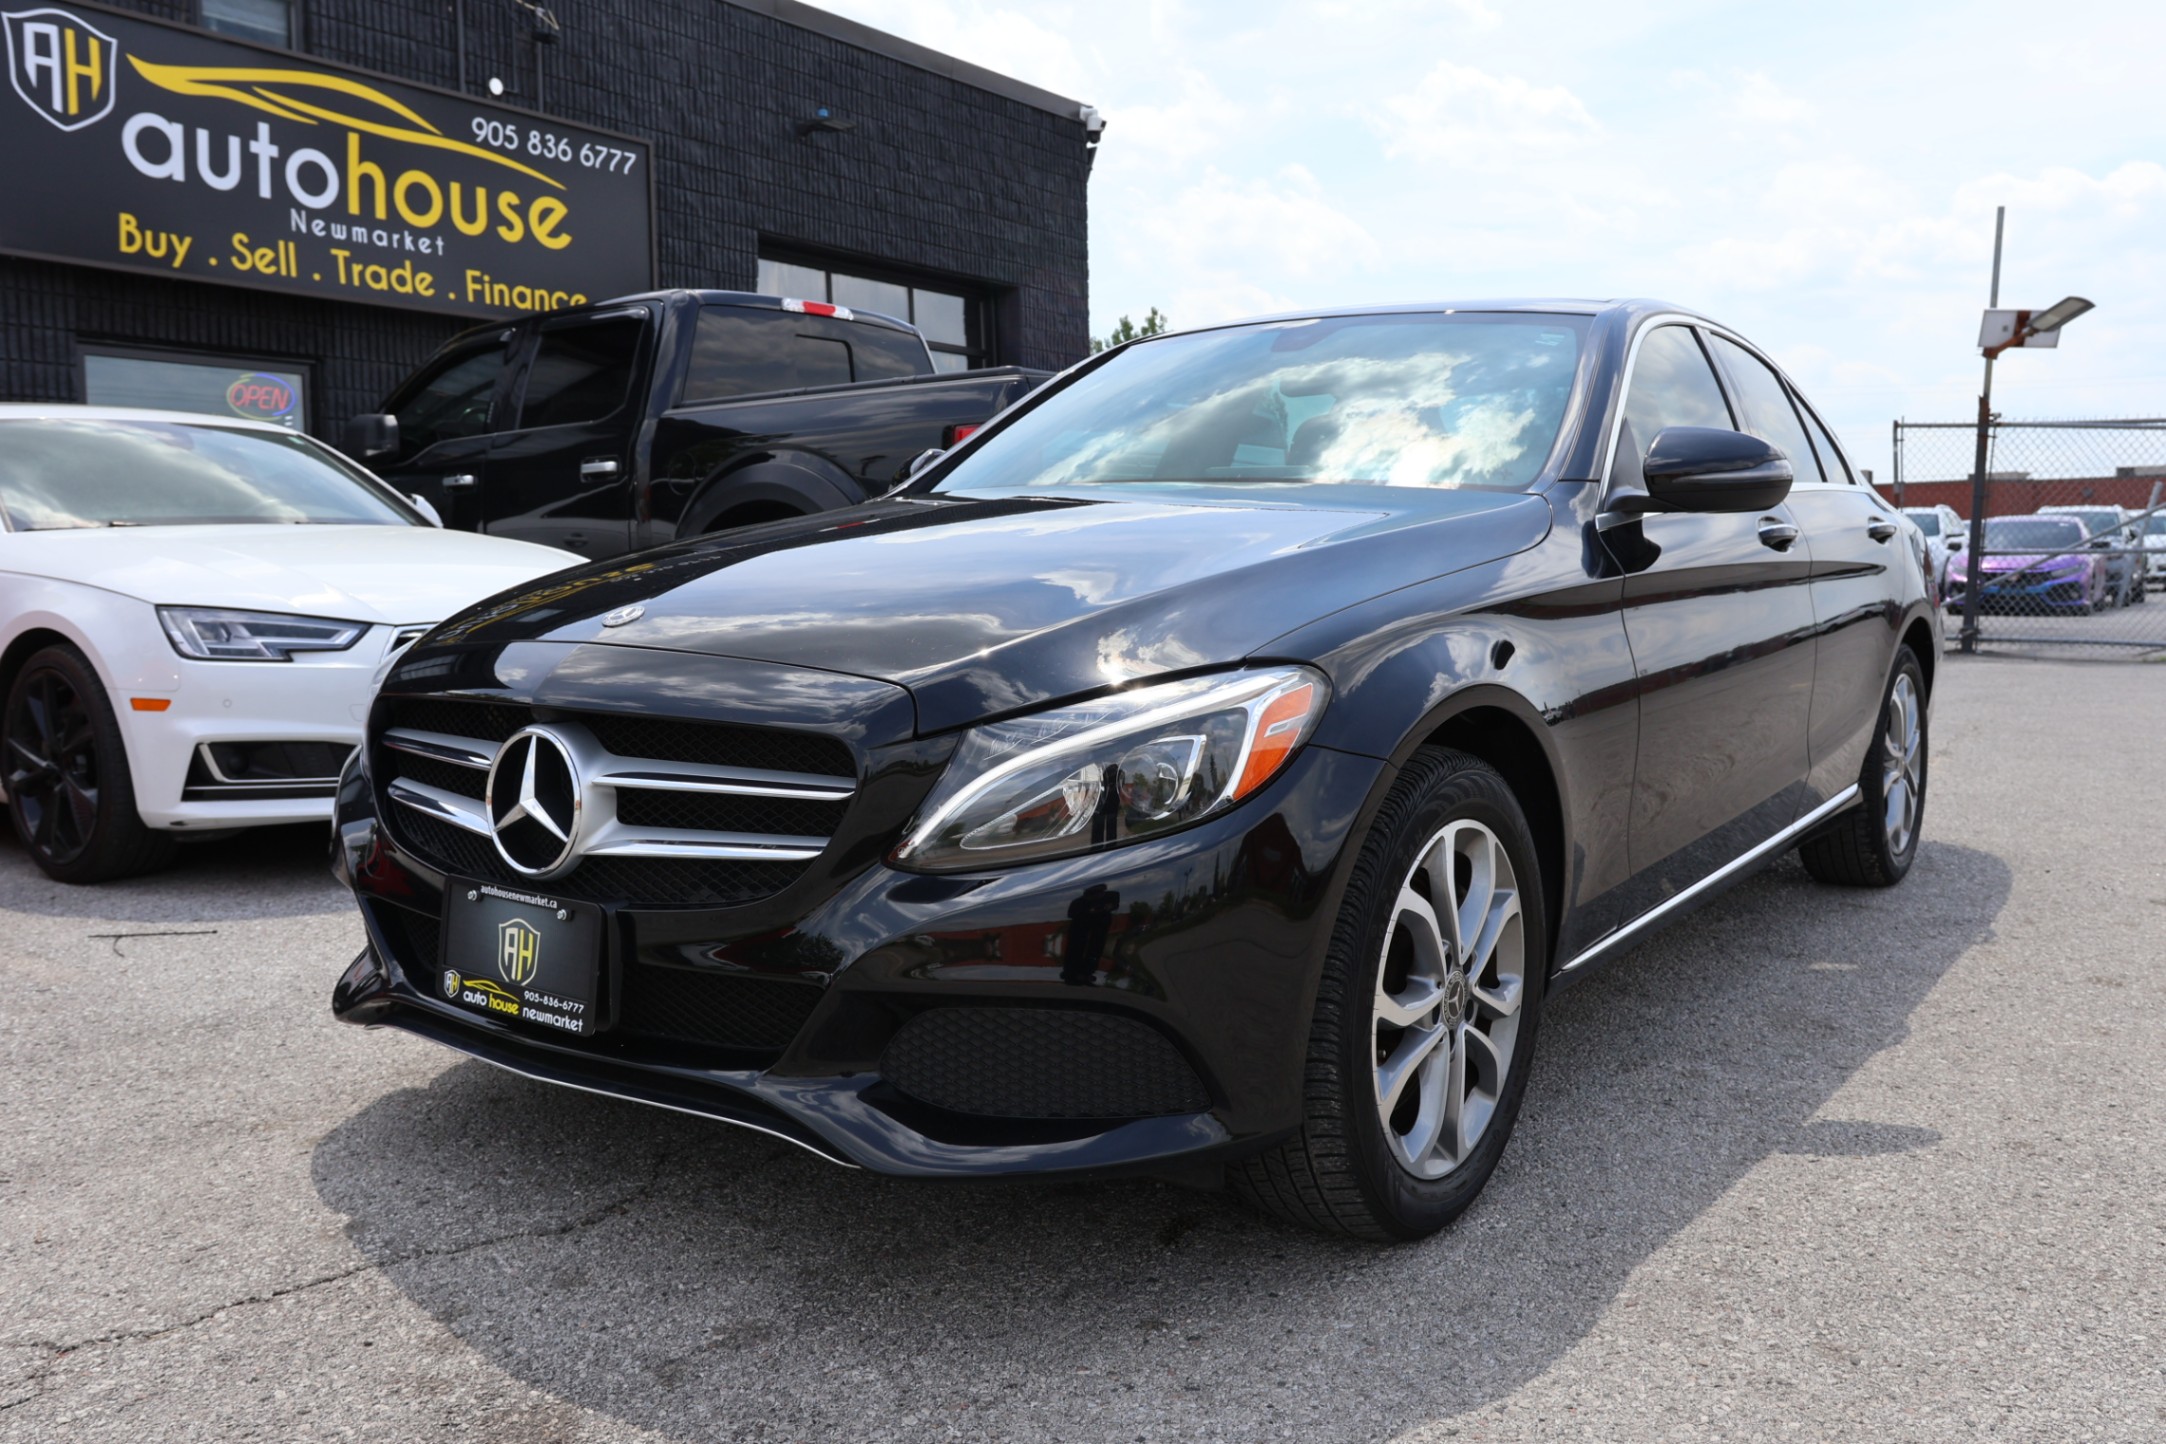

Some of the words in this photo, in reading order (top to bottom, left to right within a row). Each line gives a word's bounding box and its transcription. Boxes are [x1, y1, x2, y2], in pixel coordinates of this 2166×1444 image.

[23, 21, 101, 116] AH
[471, 116, 519, 150] 905
[527, 130, 573, 163] 836
[579, 142, 637, 176] 6777
[118, 212, 192, 268] Buy
[231, 232, 297, 278] Sell
[330, 247, 435, 297] Trade
[290, 208, 444, 256] Newmarket
[229, 383, 289, 410] OPEN
[480, 885, 557, 909] autohousenewmarket.ca
[504, 927, 534, 981] AH
[463, 990, 488, 1006] auto
[489, 993, 520, 1015] house
[522, 1006, 584, 1033] newmarket
[523, 990, 585, 1014] 905-836-6777
